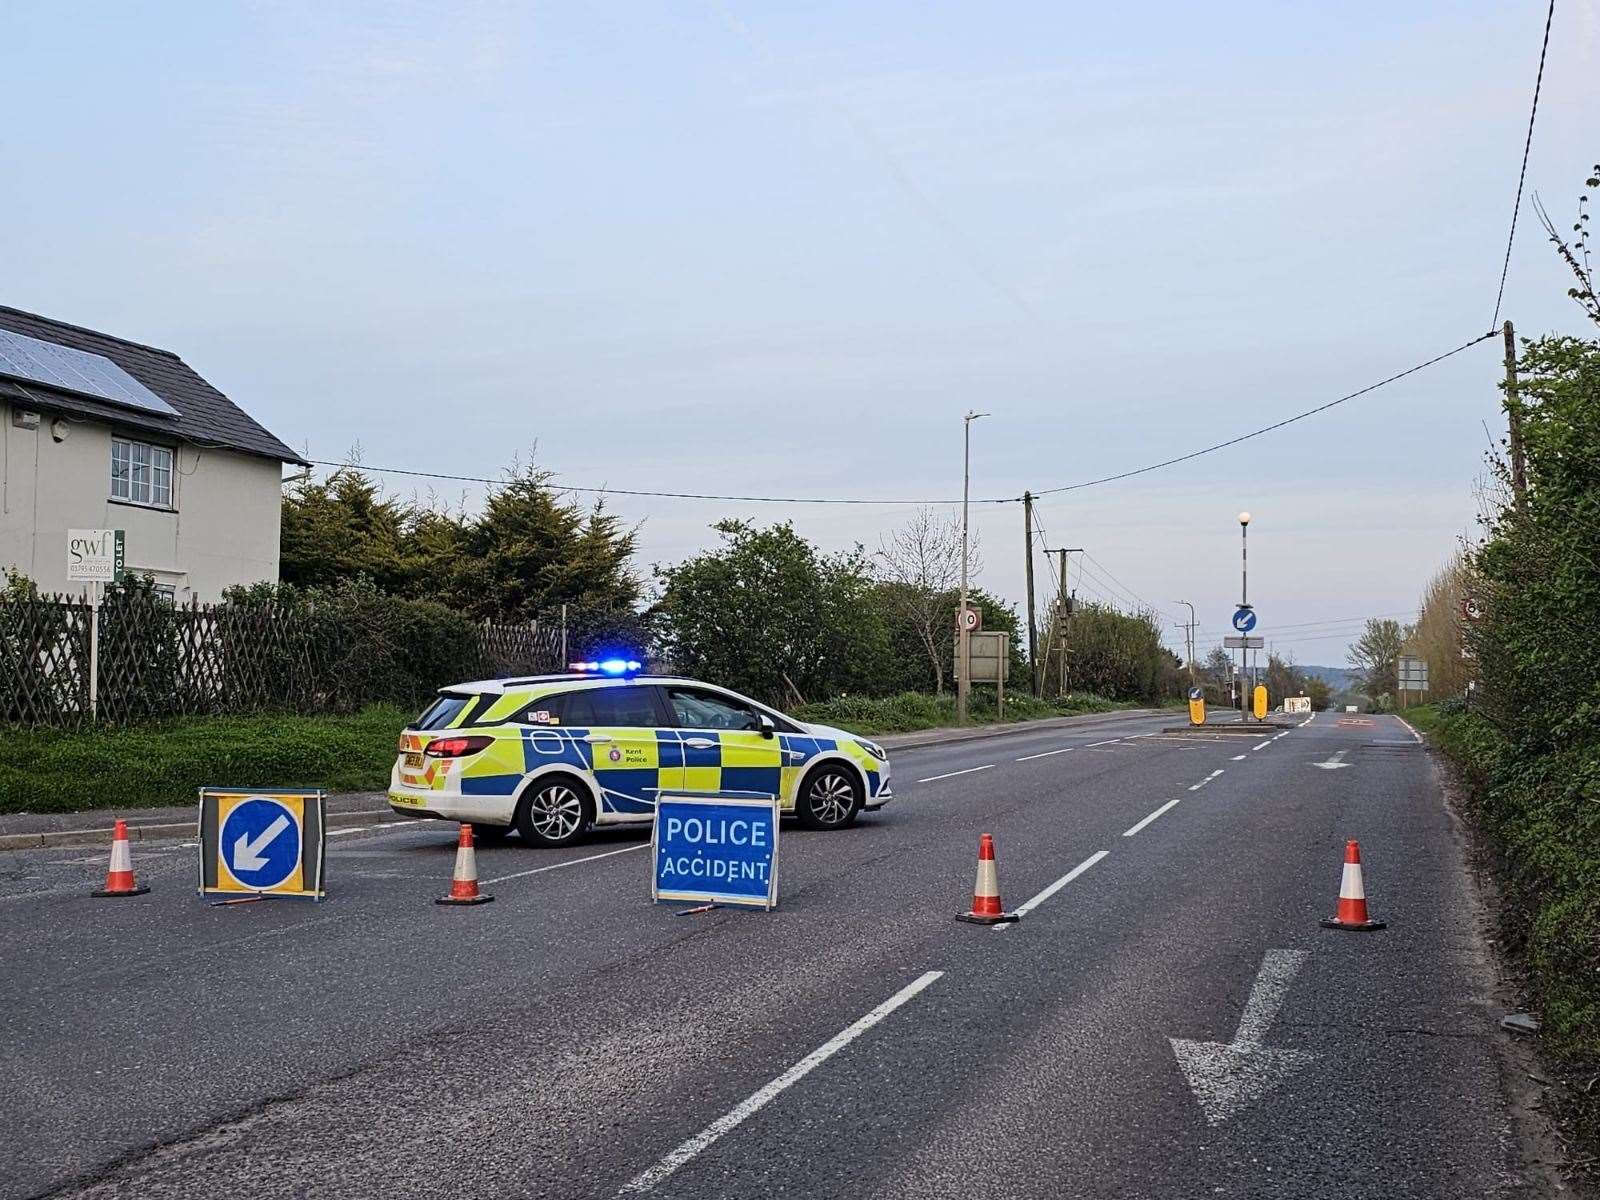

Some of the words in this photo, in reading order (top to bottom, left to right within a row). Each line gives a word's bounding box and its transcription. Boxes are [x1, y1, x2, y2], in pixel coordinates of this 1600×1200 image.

[116, 559, 122, 573] TO
[667, 818, 766, 846] POLICE
[663, 857, 768, 880] ACCIDENT
